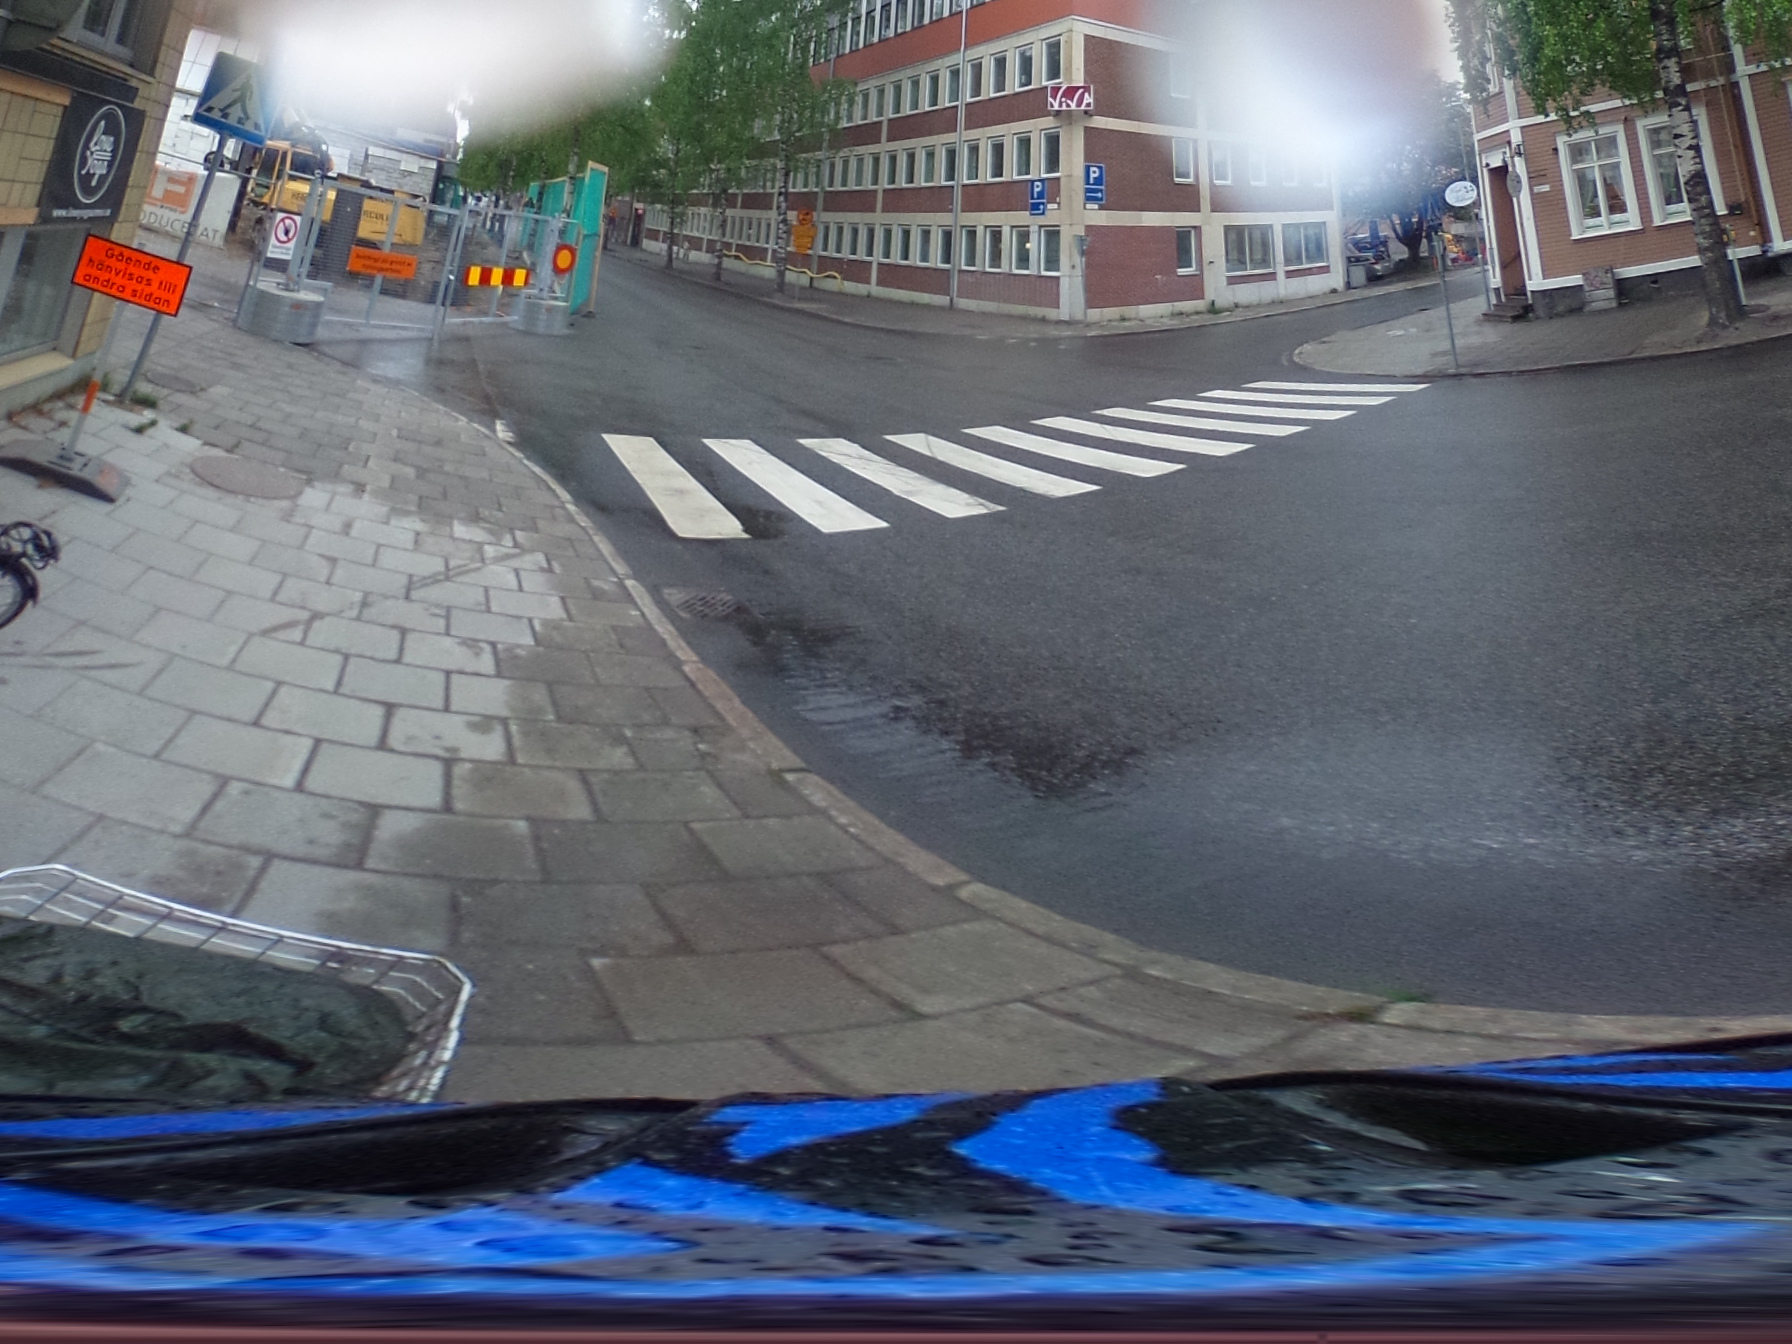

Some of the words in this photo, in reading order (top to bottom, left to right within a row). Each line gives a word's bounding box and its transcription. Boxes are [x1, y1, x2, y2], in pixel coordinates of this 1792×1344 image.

[1090, 167, 1099, 184] P
[1033, 182, 1042, 199] P
[105, 247, 161, 274] Gående
[86, 257, 152, 287] hänvisas
[157, 279, 178, 295] till
[83, 274, 126, 293] andra
[130, 288, 171, 309] sidan
